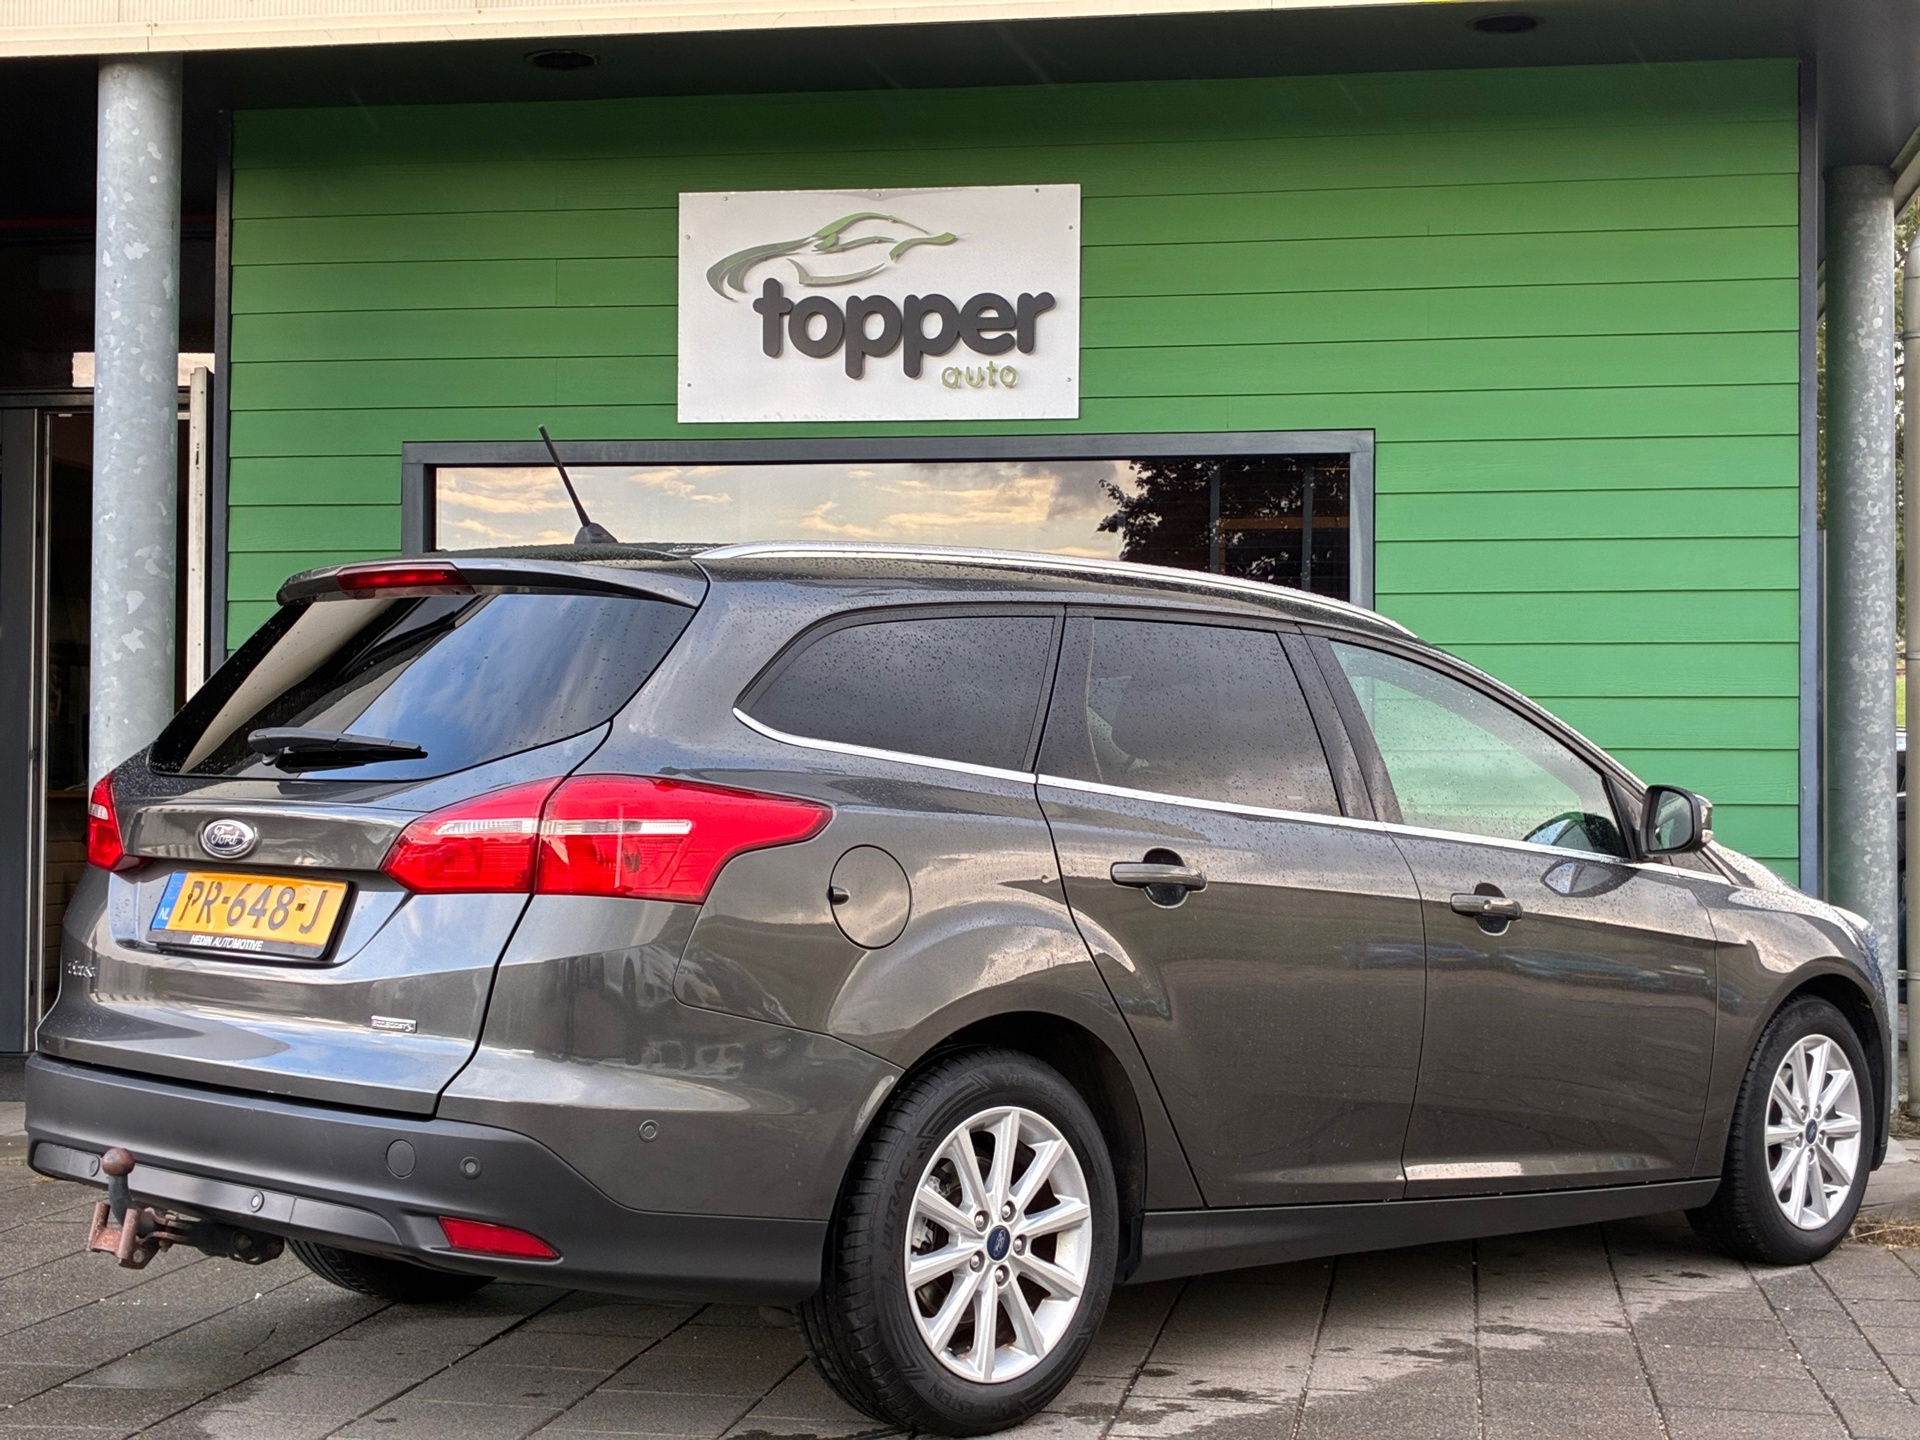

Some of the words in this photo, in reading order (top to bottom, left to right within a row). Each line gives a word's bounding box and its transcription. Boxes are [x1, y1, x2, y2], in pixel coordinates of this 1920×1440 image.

[753, 277, 1057, 379] topper
[941, 360, 1018, 389] auto
[211, 825, 240, 845] Ford
[158, 907, 170, 920] NL
[178, 880, 329, 934] PR-648-J
[189, 934, 213, 947] HEDIN
[212, 936, 263, 951] AUTOMOTIVE
